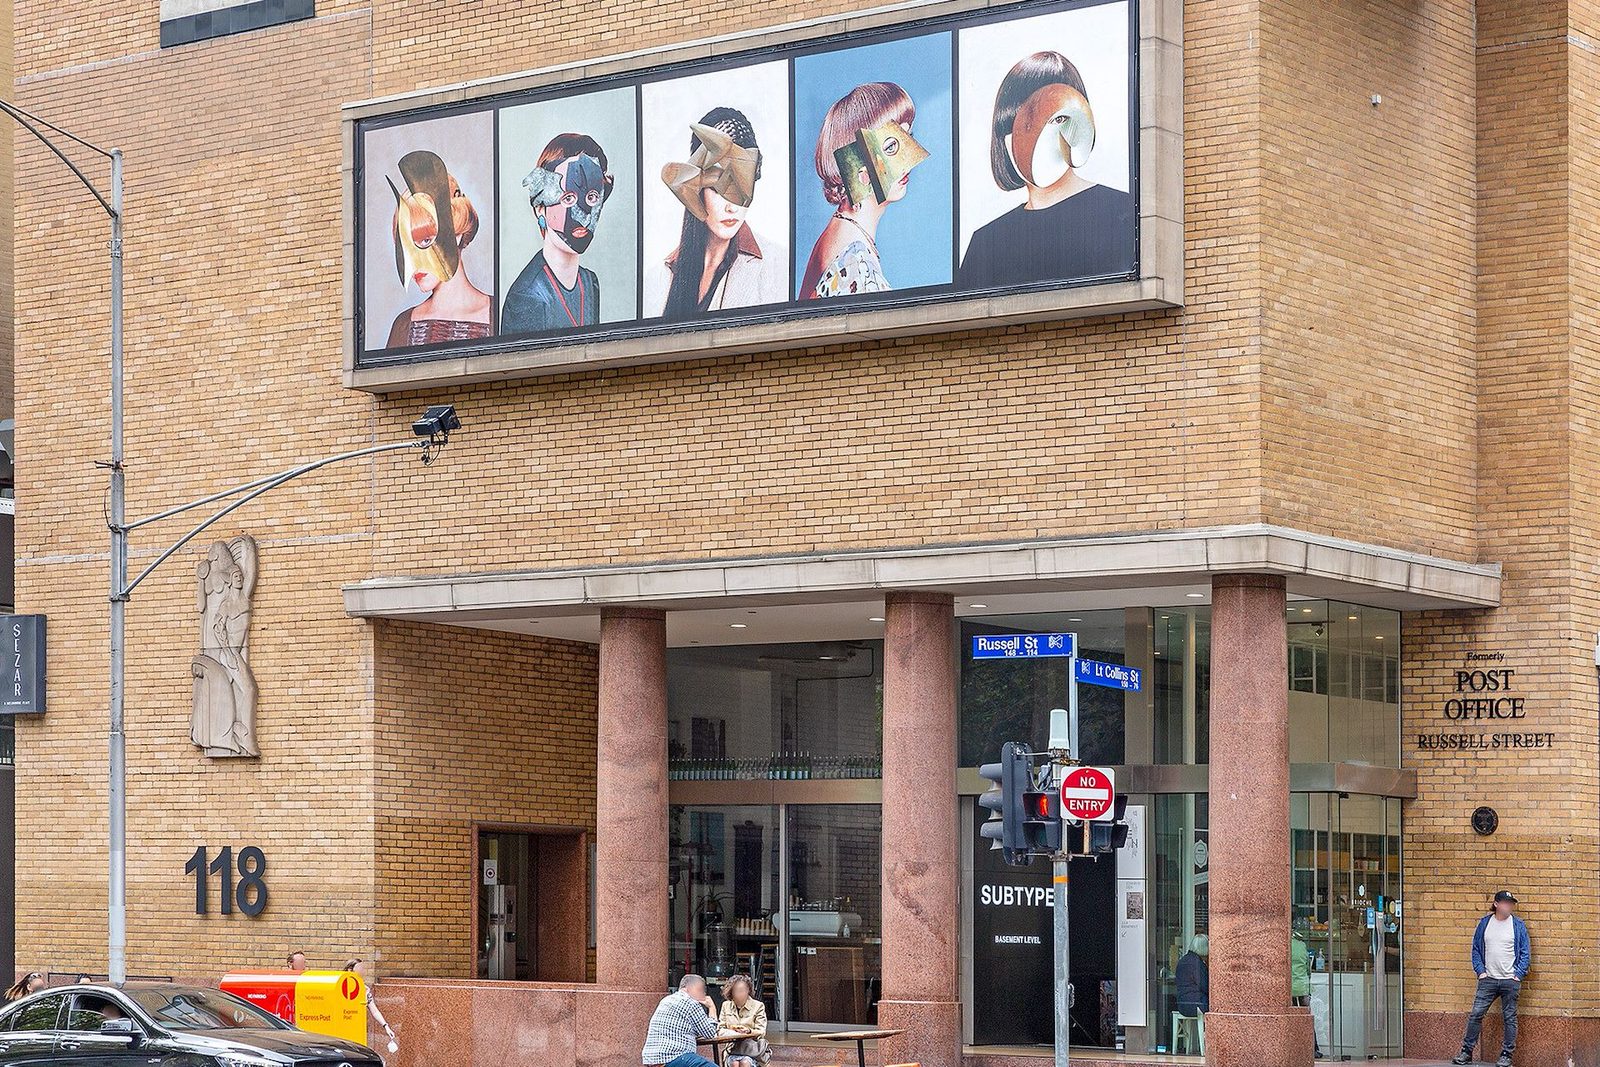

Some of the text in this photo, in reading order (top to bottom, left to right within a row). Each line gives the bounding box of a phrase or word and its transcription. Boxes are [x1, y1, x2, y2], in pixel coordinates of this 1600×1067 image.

[978, 636, 1039, 651] Russell St
[13, 624, 22, 696] SEZAR
[1466, 652, 1505, 662] Formerly
[1095, 664, 1139, 683] Lt Collins St
[1456, 669, 1515, 692] POST
[1444, 697, 1526, 720] OFFICE
[1418, 732, 1555, 749] RUSSELL STREET
[1079, 776, 1097, 787] NO
[1069, 799, 1106, 812] ENTRY
[185, 845, 268, 918] 118
[980, 884, 1054, 907] SUBTYPE
[995, 935, 1041, 944] BASEMENT LEVEL
[299, 1013, 331, 1022] Express Post
